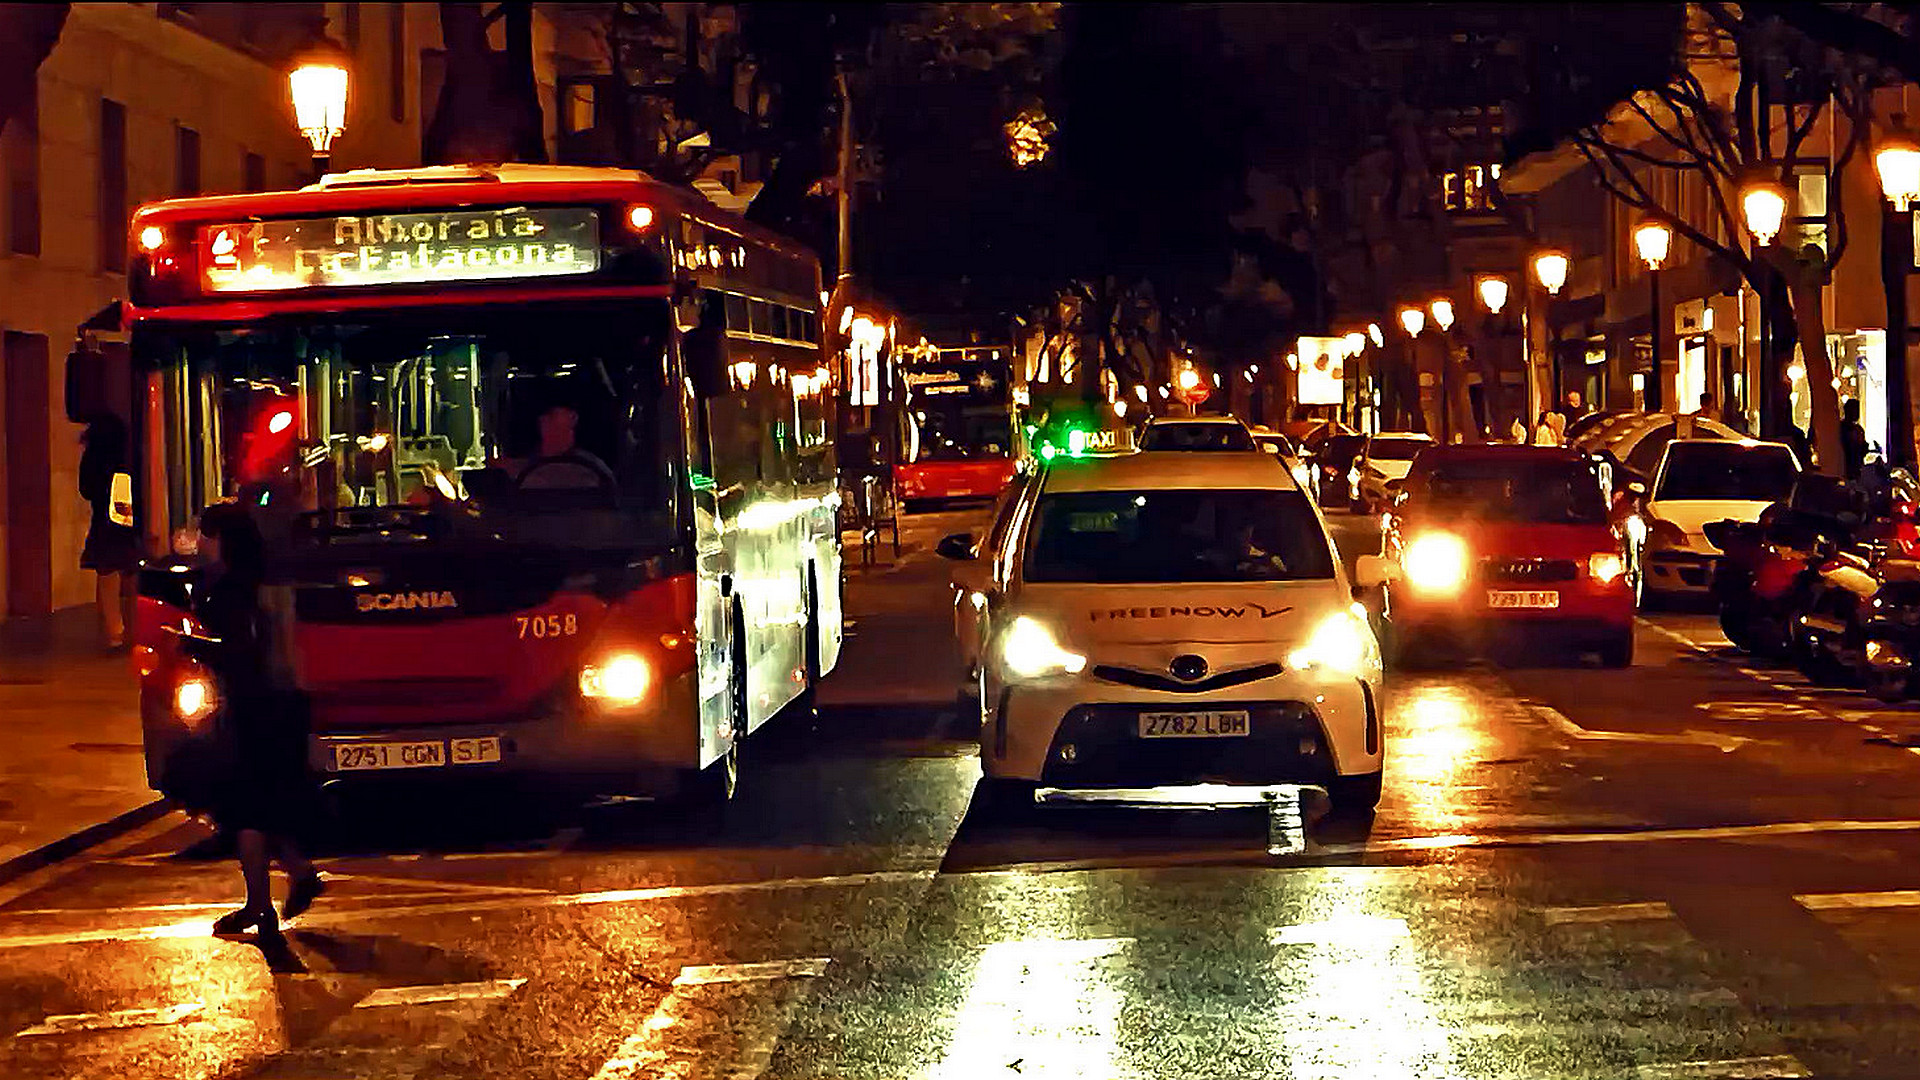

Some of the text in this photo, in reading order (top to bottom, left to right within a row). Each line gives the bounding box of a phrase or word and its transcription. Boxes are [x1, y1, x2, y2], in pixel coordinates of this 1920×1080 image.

[1084, 431, 1115, 448] TAXI
[356, 591, 457, 612] SCANIA
[516, 613, 577, 639] 7058
[1146, 714, 1198, 735] 2782
[340, 745, 390, 769] 2751
